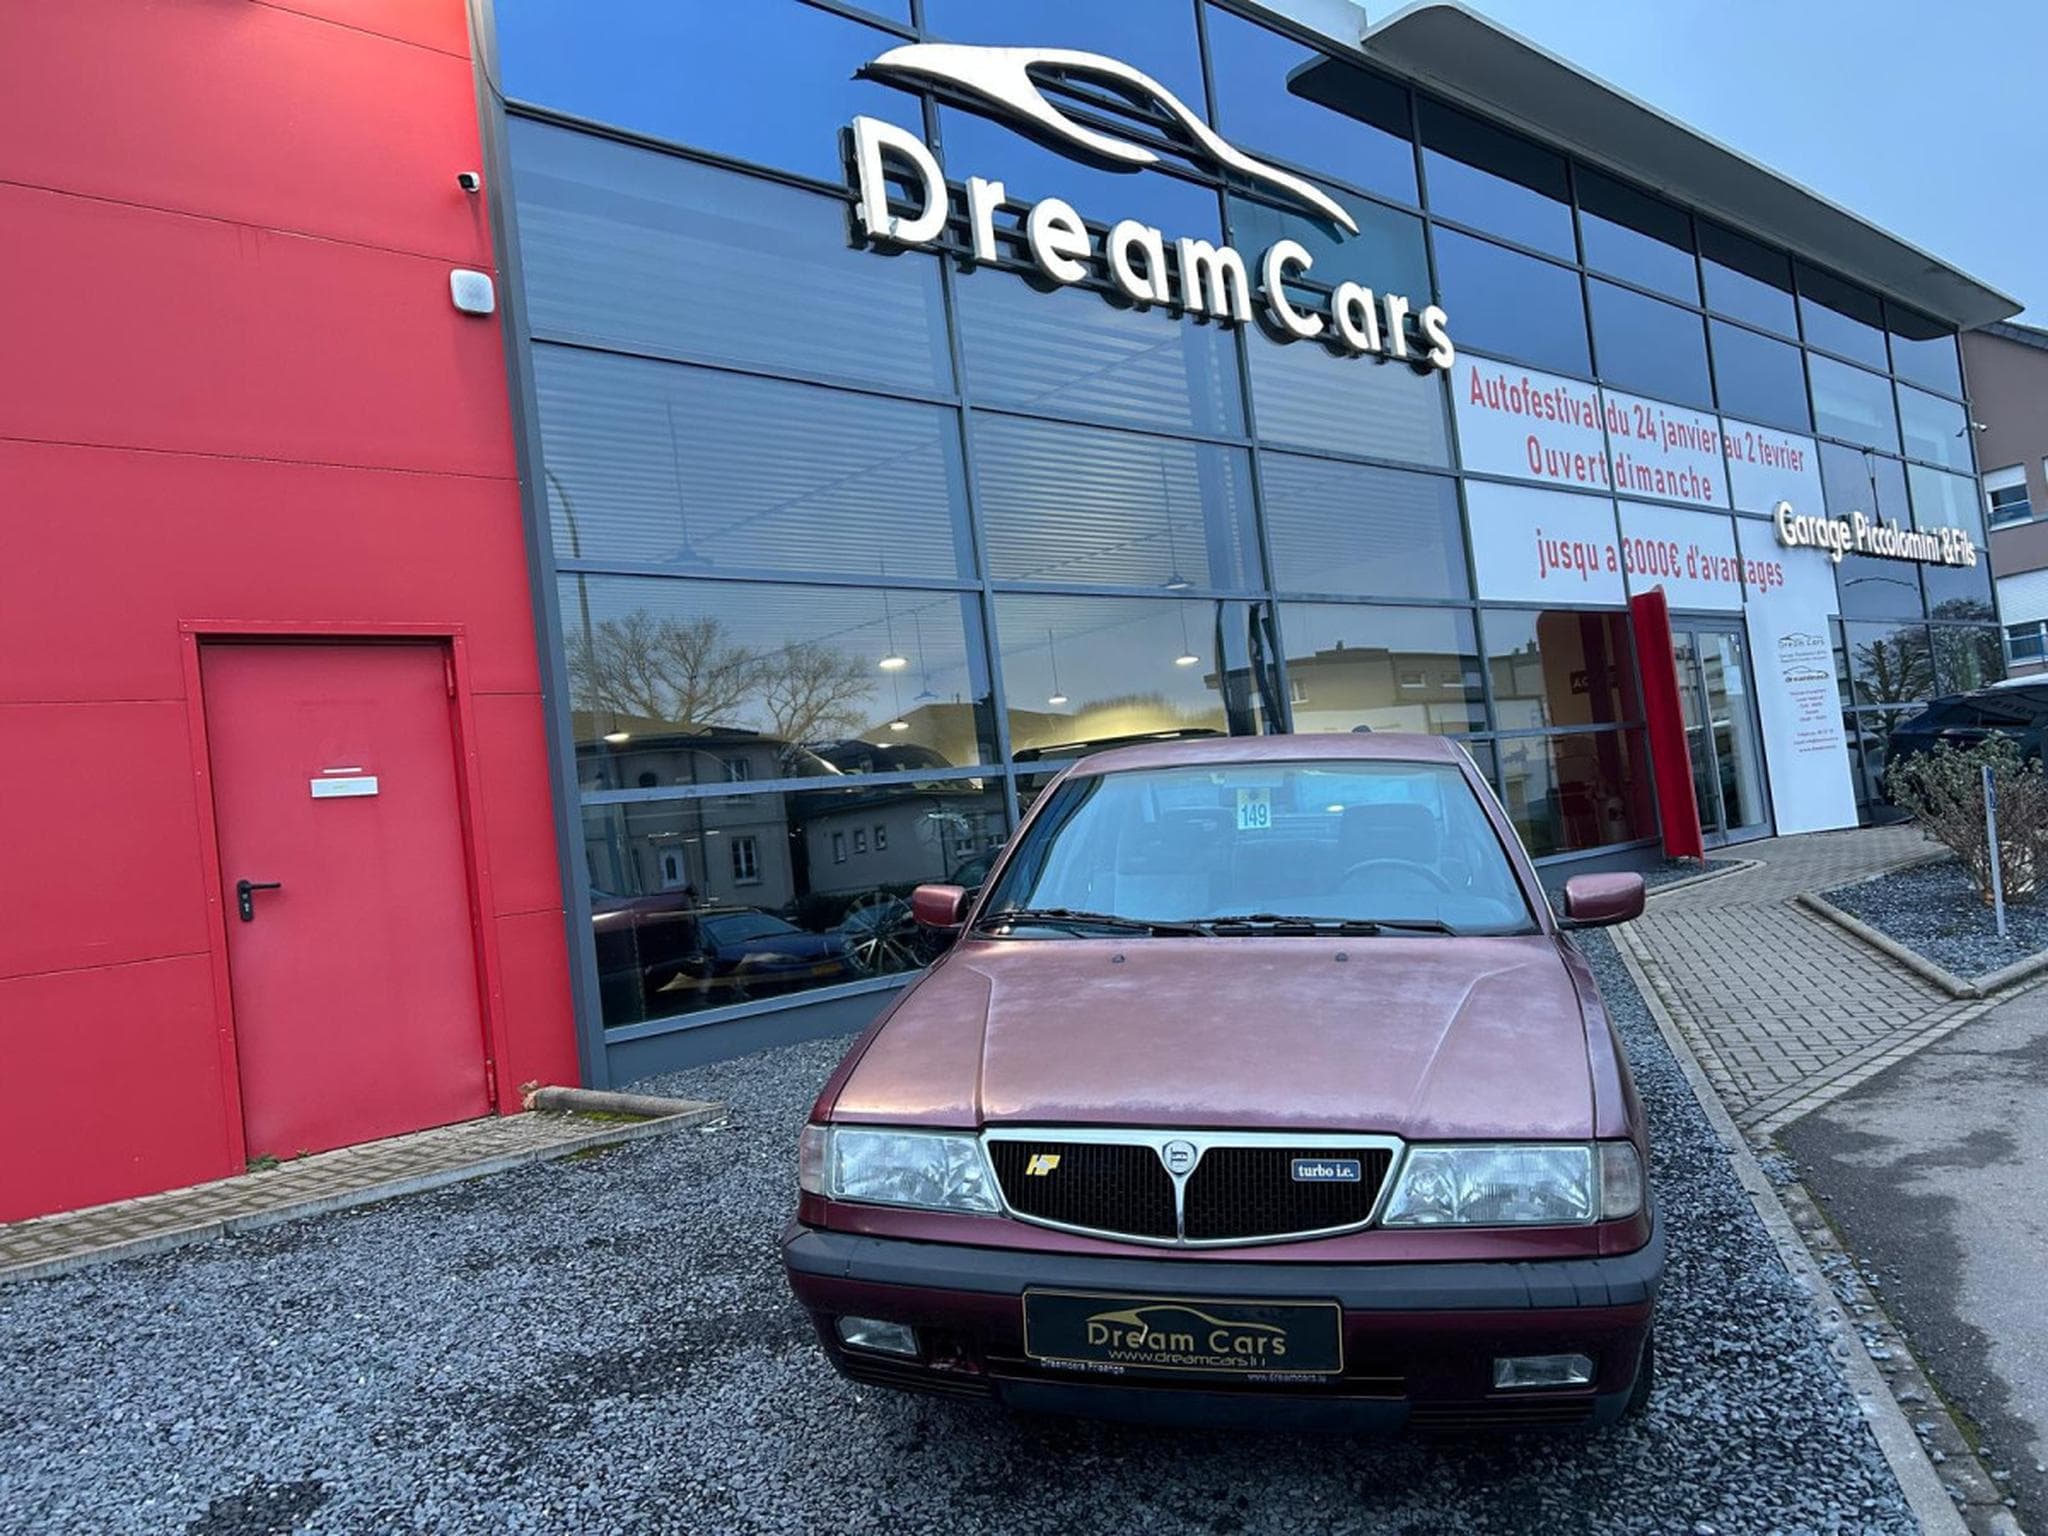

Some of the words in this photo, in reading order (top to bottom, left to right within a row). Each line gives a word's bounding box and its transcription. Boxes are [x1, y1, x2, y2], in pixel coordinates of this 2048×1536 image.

[1470, 365, 1602, 432] Autofestival
[1607, 399, 1631, 437] du
[1633, 403, 1657, 442] 24
[1660, 410, 1718, 454] janvier
[1724, 434, 1743, 461] au
[1744, 431, 1756, 463] 2
[1758, 434, 1804, 472] fevrier
[1526, 434, 1608, 485] Ouvert
[1615, 451, 1713, 502] dimanche
[1536, 528, 1599, 582] jusqu
[1606, 544, 1618, 573] a
[1622, 537, 1682, 579] 3000€
[1776, 500, 1854, 563] Garage
[1852, 511, 1941, 562] Piccolomini
[1241, 803, 1268, 827] 149
[1298, 1163, 1334, 1178] turbo
[1336, 1163, 1355, 1178] i.e.
[1087, 1321, 1195, 1352] Dream
[1208, 1329, 1287, 1356] Cars
